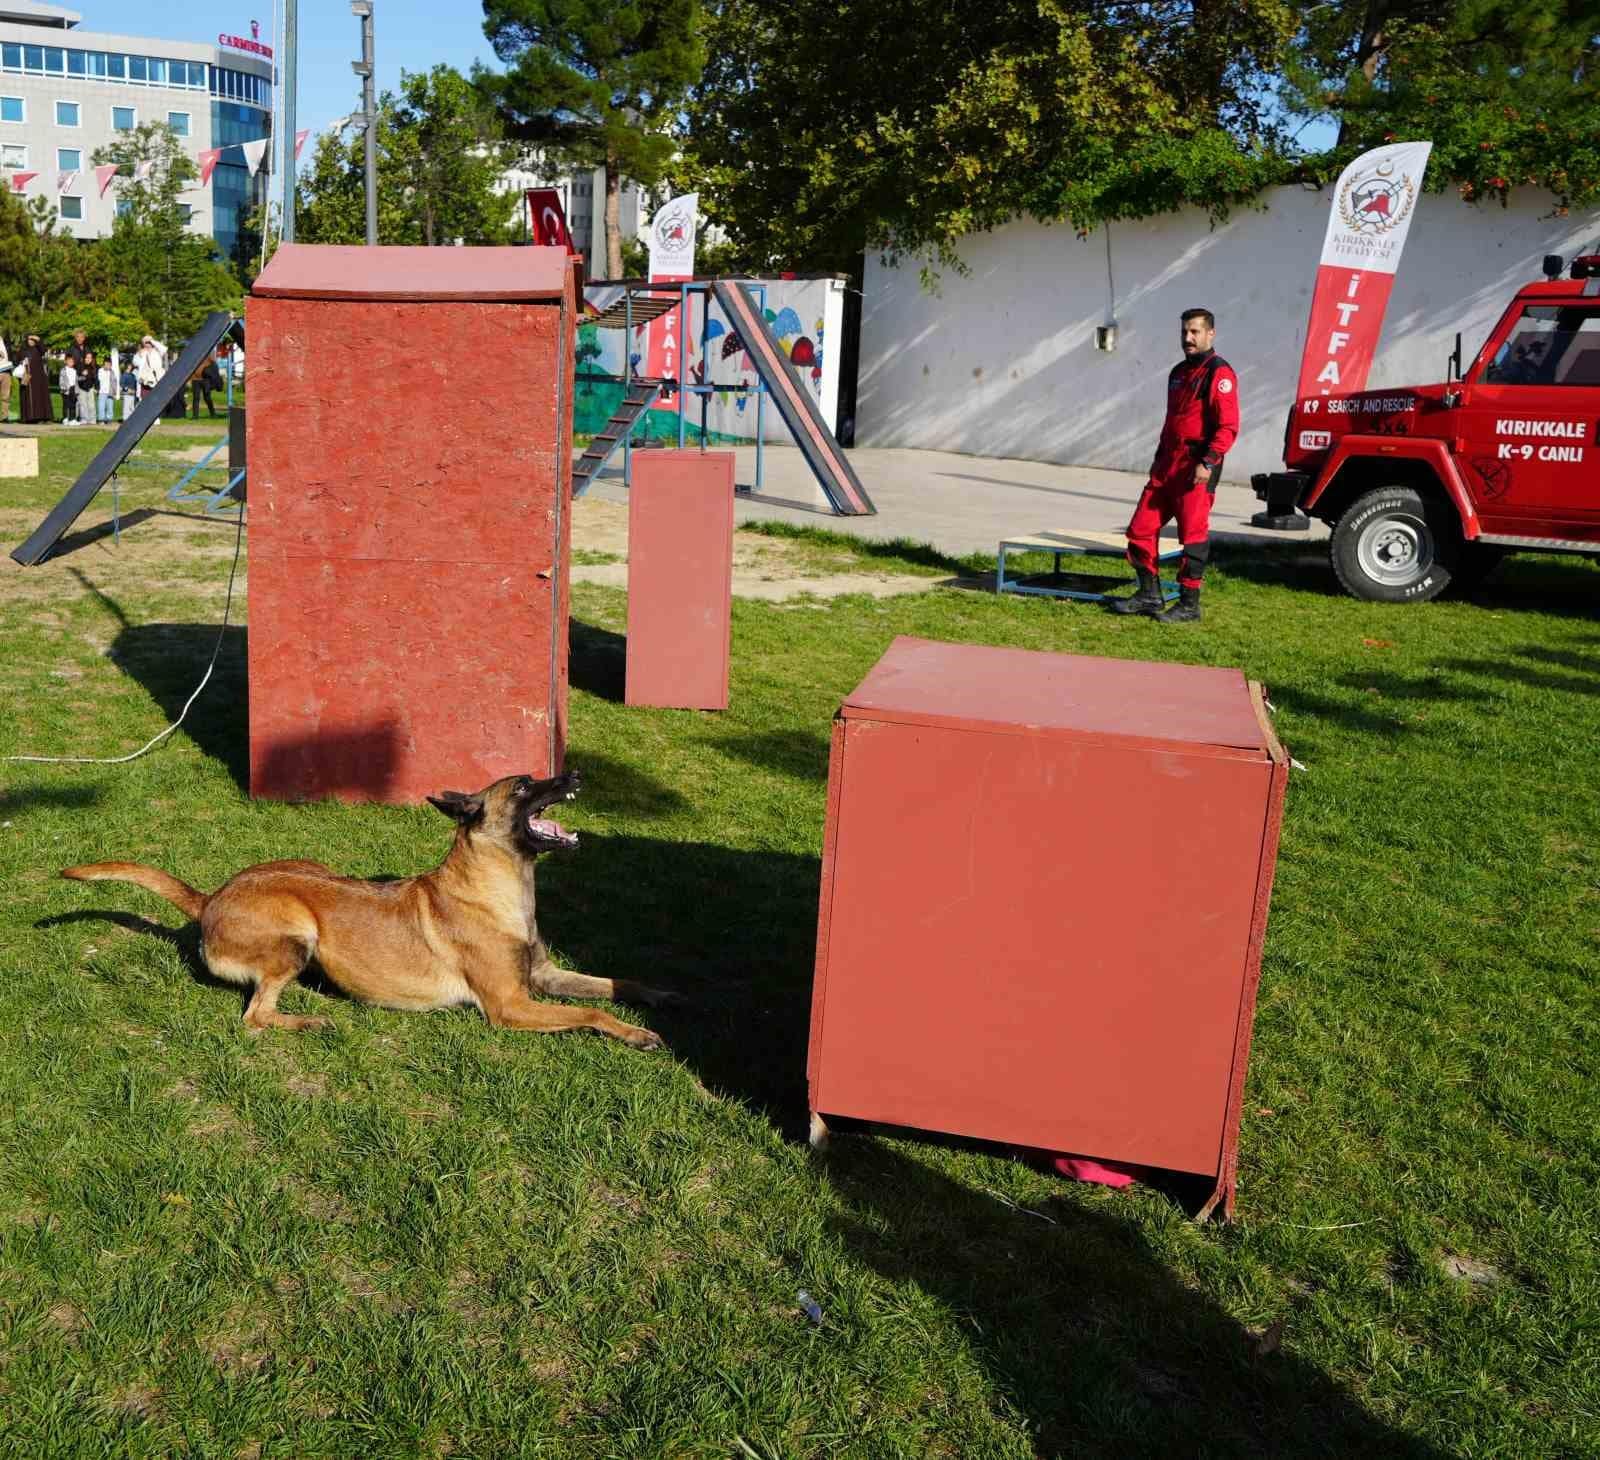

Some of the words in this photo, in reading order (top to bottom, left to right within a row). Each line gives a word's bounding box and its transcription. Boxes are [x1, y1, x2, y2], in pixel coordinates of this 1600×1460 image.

[1304, 400, 1319, 414] K9
[1327, 400, 1360, 414] SEARCH
[1362, 399, 1381, 413] AND
[1382, 398, 1415, 412] RESCUE
[1496, 419, 1586, 438] KIRIKKALE
[1497, 444, 1534, 459] K-9
[1538, 446, 1583, 462] CANLI
